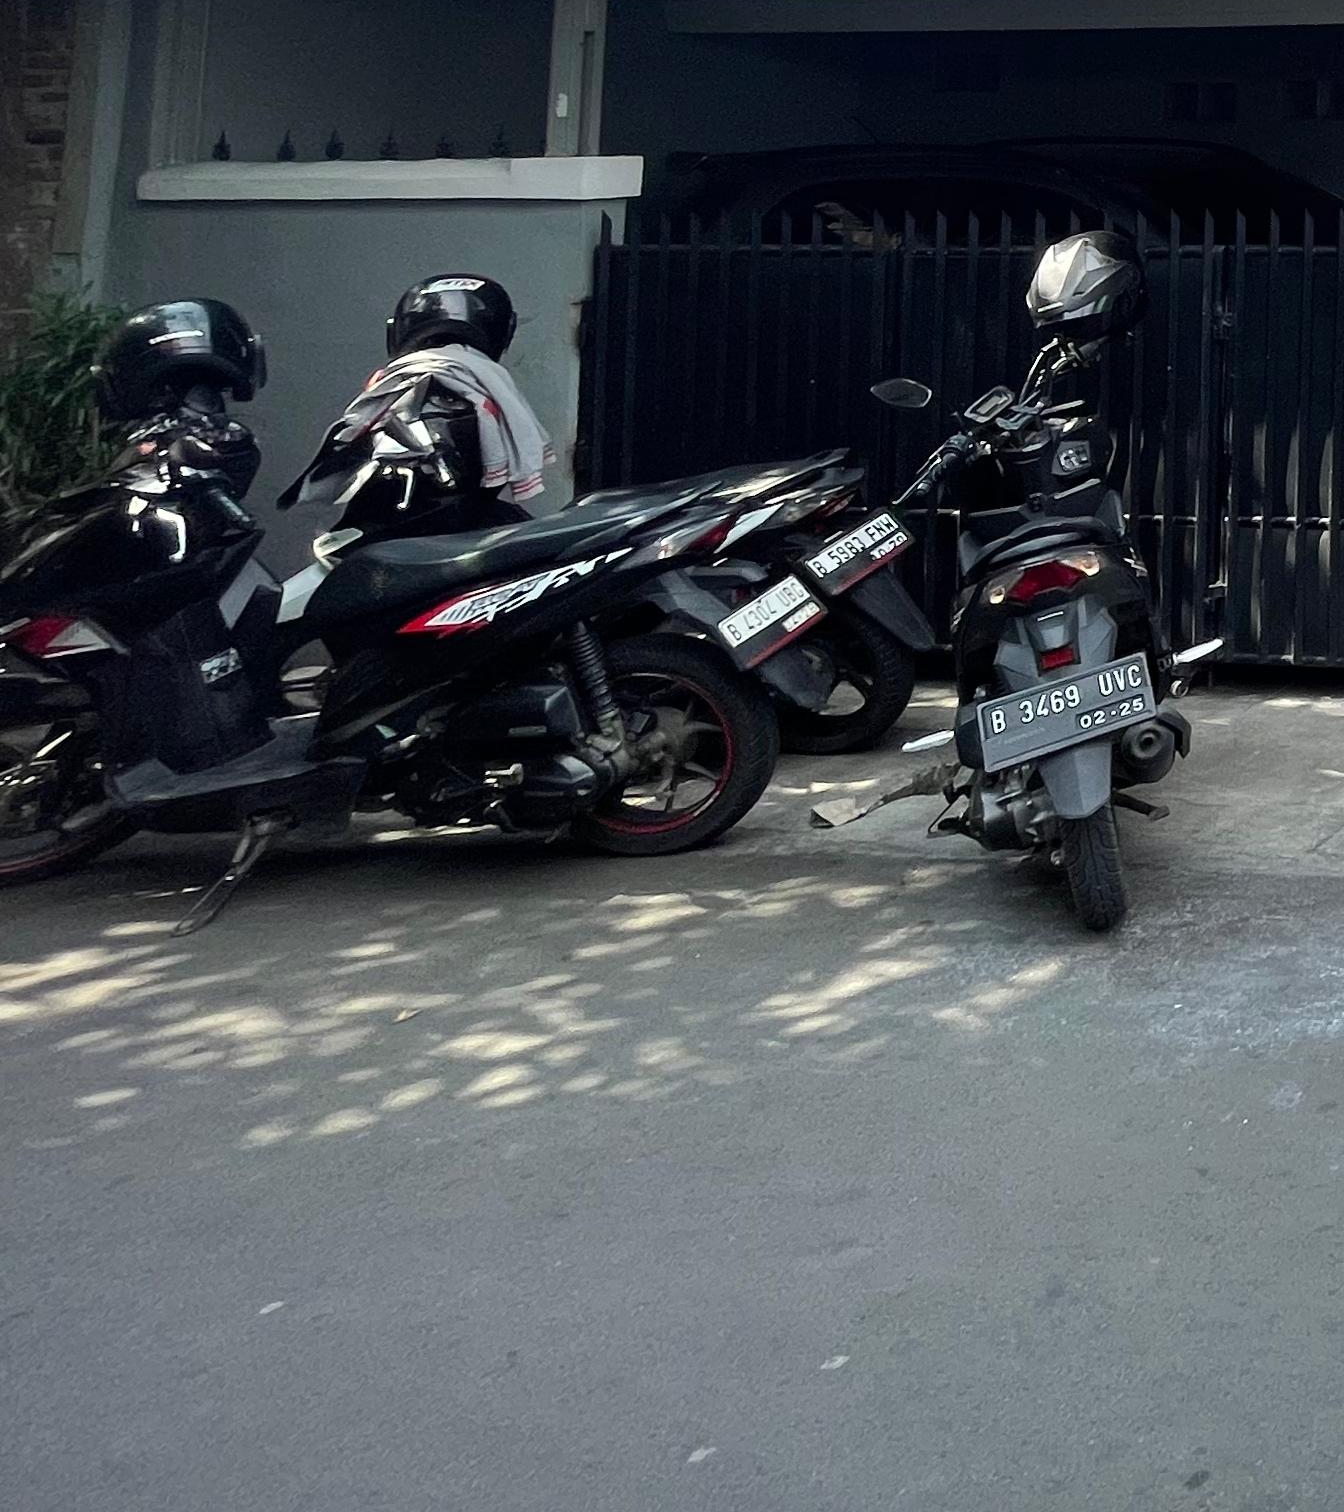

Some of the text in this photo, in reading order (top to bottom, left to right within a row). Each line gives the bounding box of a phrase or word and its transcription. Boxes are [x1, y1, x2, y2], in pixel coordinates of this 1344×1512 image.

[812, 560, 828, 574] B
[726, 623, 742, 641] B
[743, 598, 777, 630] 4304
[990, 664, 1142, 734] B 3469 UVC
